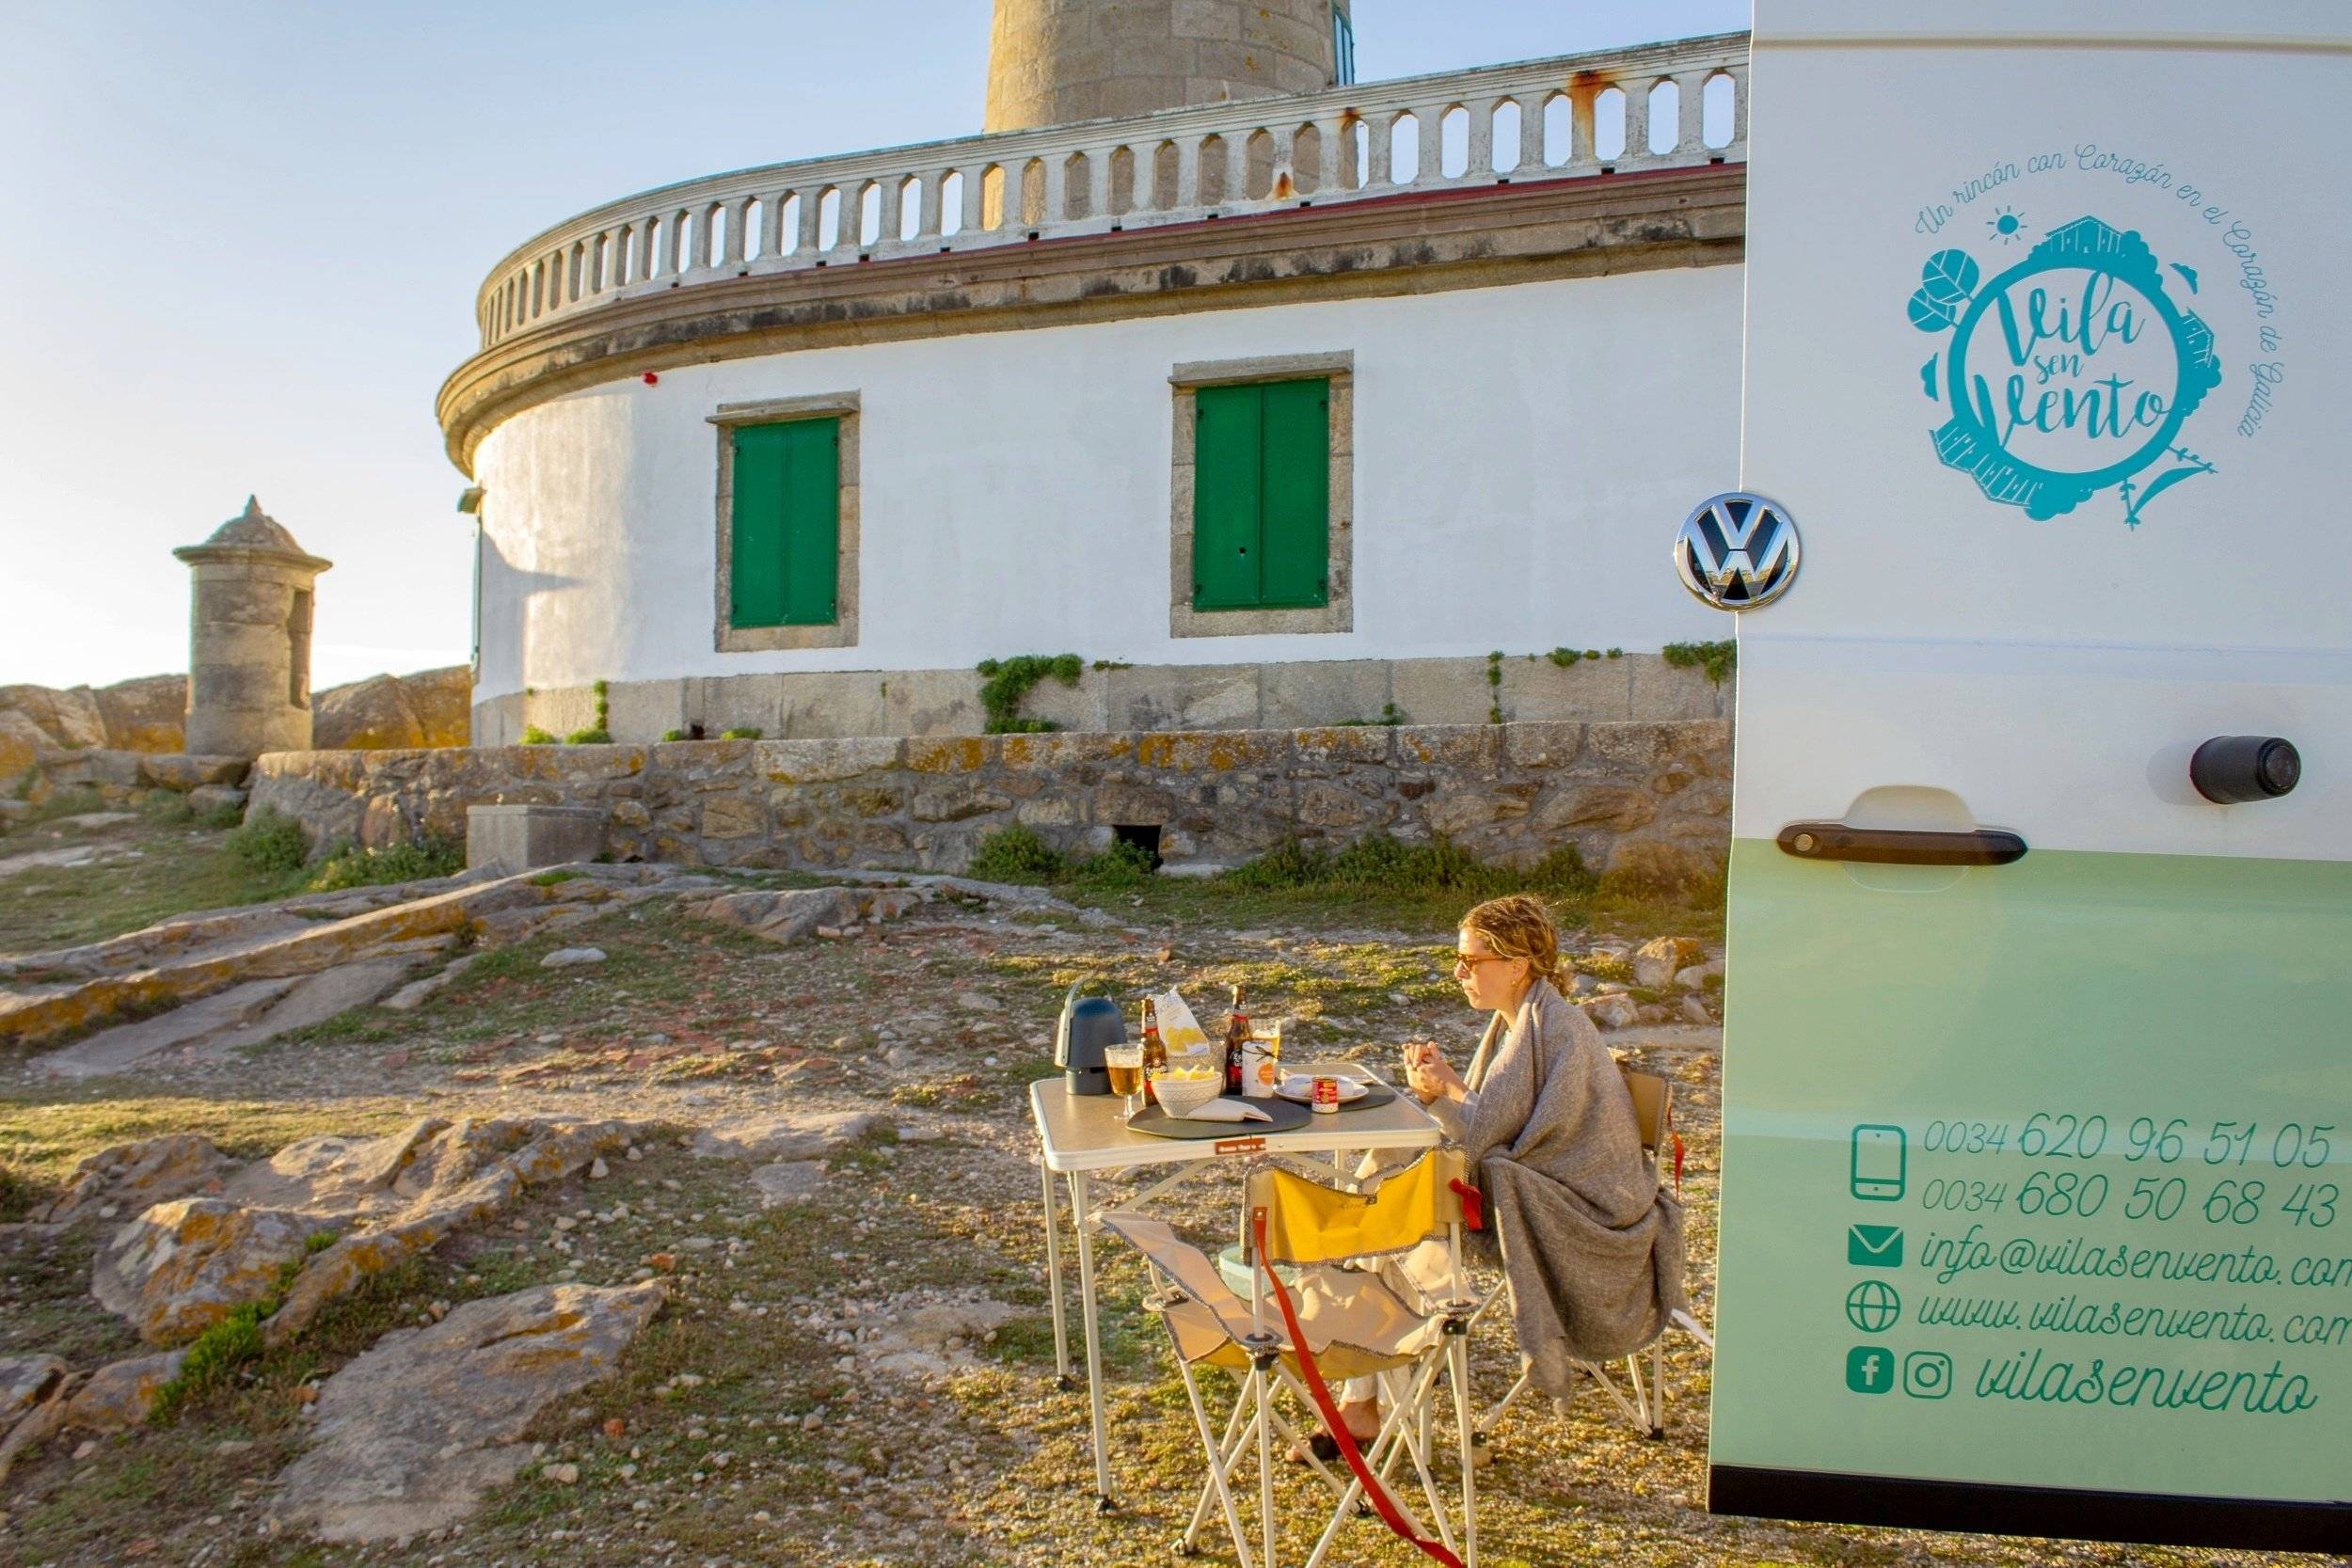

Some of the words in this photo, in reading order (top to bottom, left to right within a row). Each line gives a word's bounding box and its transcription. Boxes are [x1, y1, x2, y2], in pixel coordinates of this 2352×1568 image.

[1951, 161, 2020, 204] rincón
[2027, 151, 2066, 174] con
[2074, 143, 2172, 190] Corazón
[2176, 184, 2201, 208] en
[2201, 203, 2230, 226] el
[2222, 220, 2279, 319] Corazón
[1996, 269, 2146, 367] Vila
[2259, 325, 2283, 354] de
[2034, 353, 2085, 385] sen
[1973, 372, 2169, 450] Vento
[2236, 361, 2285, 439] Galicia
[1923, 1119, 2009, 1156] 0034
[2017, 1112, 2107, 1160] 620
[2123, 1117, 2188, 1164] 96
[2202, 1121, 2257, 1166] 51
[2273, 1123, 2336, 1168] 05
[1921, 1178, 2009, 1213] 0034
[2016, 1171, 2109, 1217] 680
[2124, 1177, 2187, 1221] 50
[2202, 1180, 2266, 1225] 68
[2281, 1182, 2340, 1228] 43
[1975, 1348, 2318, 1415] vilasenvento
